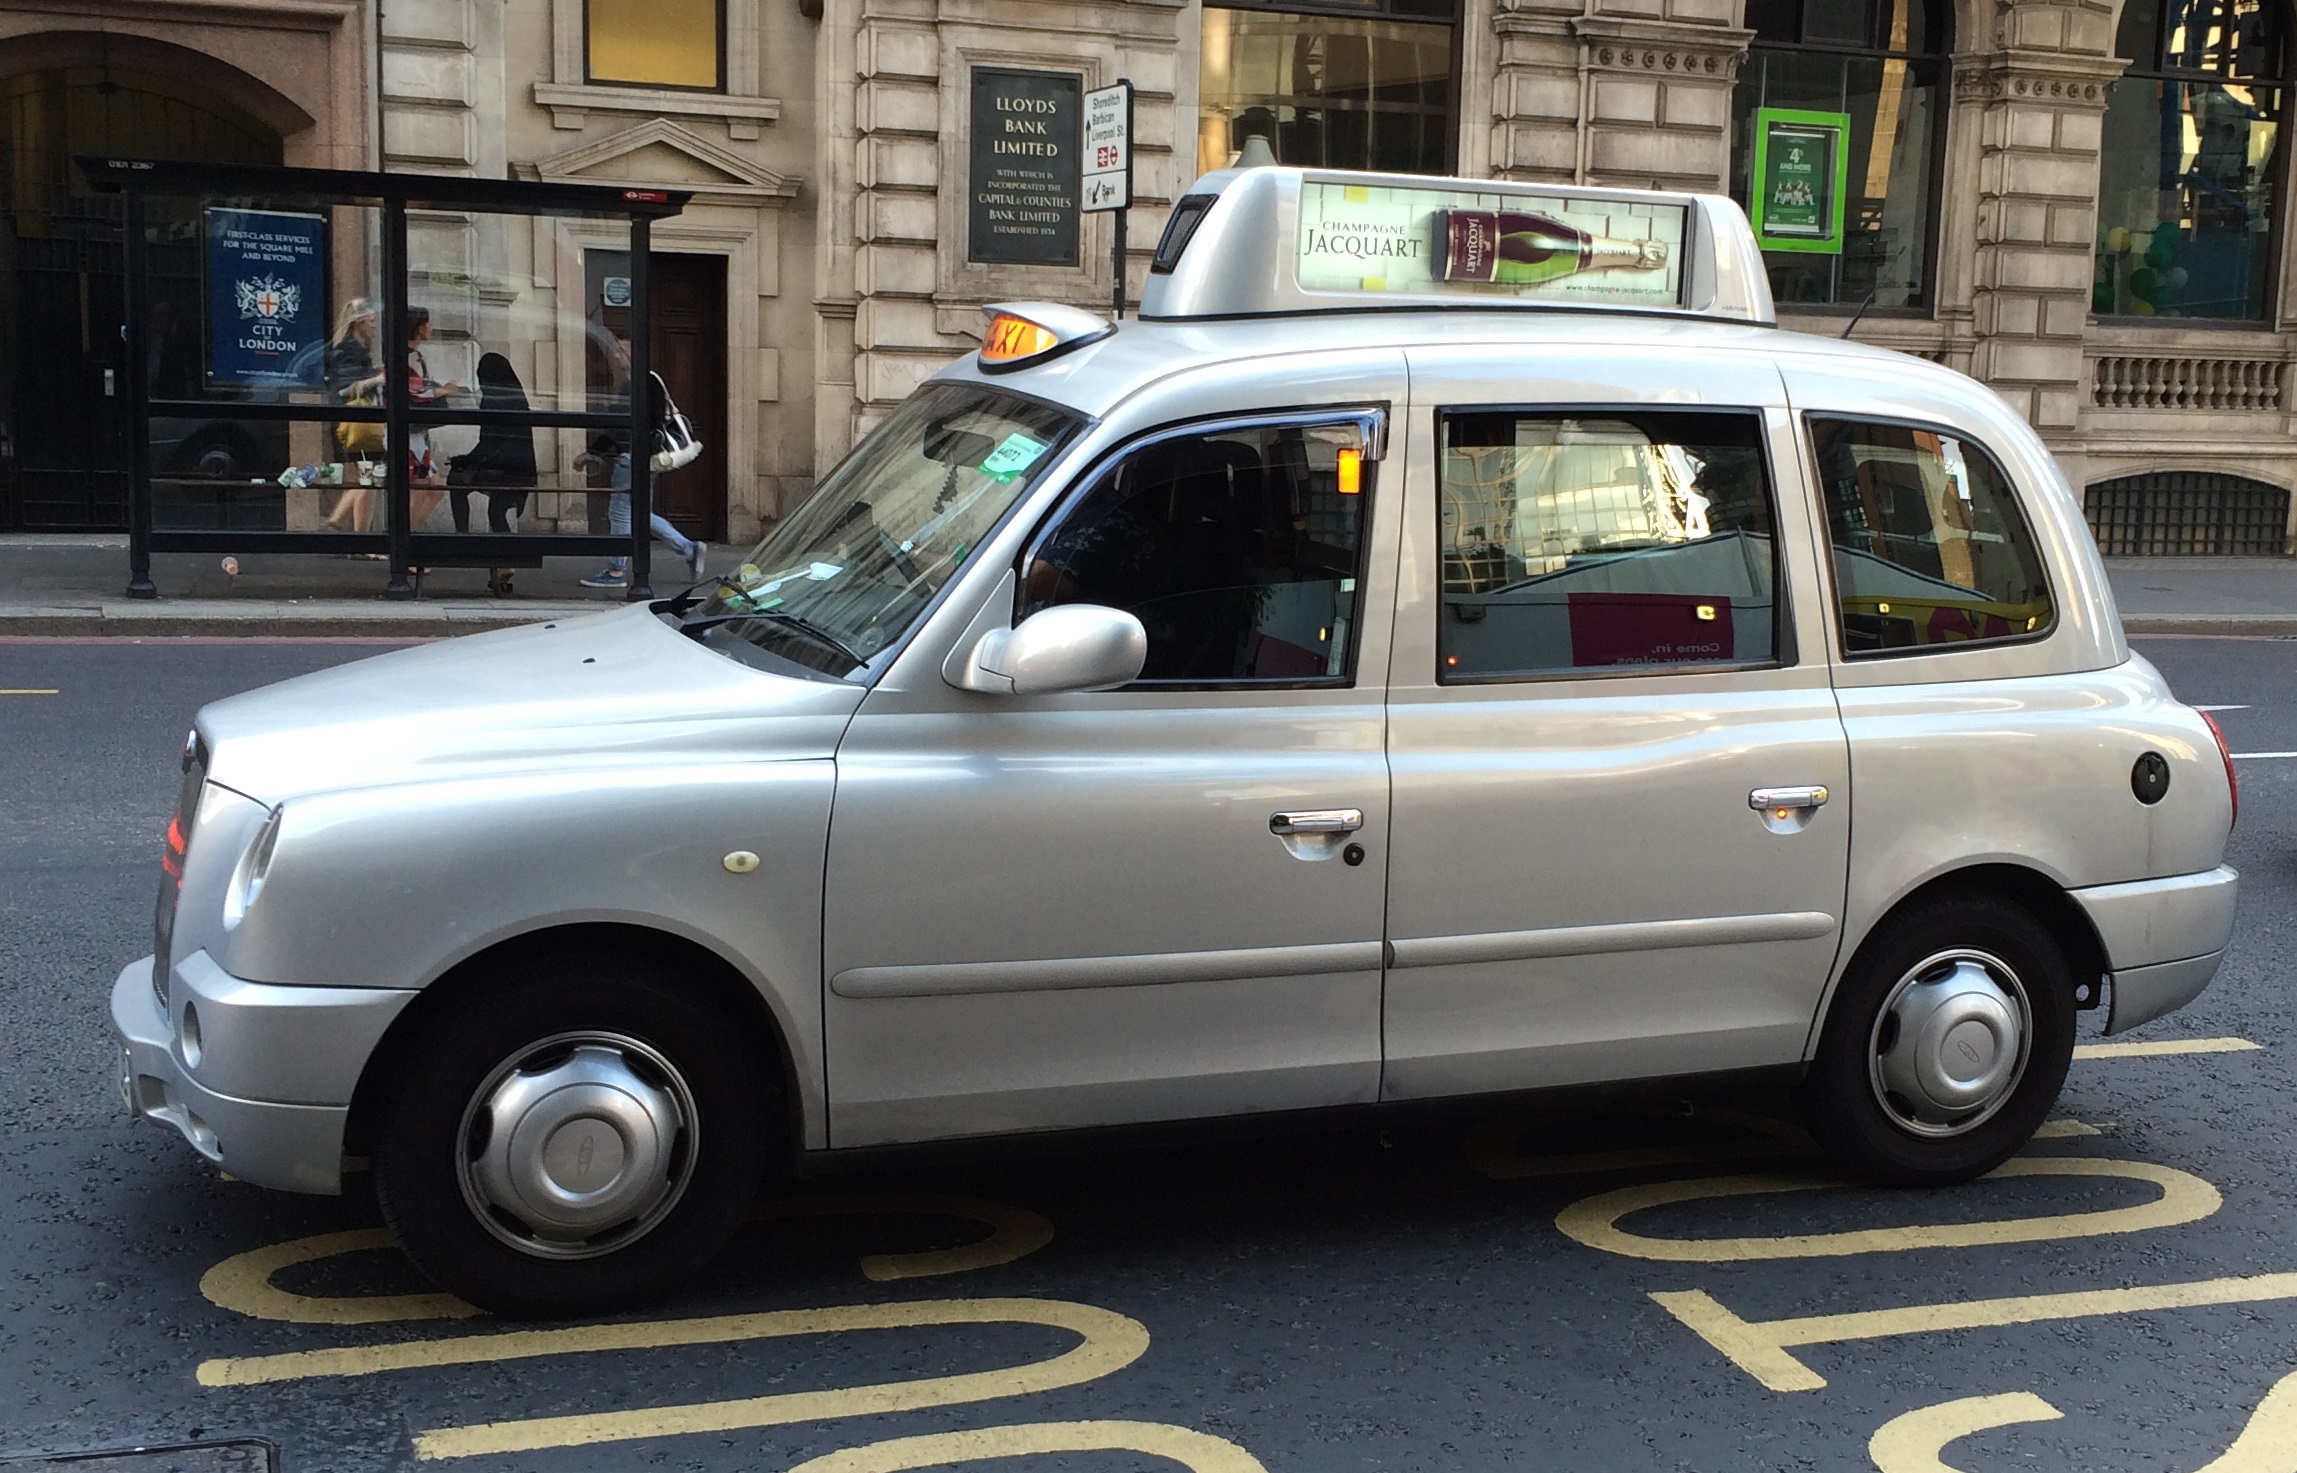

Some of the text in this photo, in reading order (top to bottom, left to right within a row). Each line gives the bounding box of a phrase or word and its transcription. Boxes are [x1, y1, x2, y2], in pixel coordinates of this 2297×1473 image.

[996, 97, 1056, 114] LLOYDS
[1093, 94, 1120, 110] Shoreditch
[1092, 112, 1114, 126] Barbican
[1005, 119, 1047, 135] BANK
[1092, 126, 1115, 141] Liverpool
[994, 140, 1058, 157] LIMITED
[996, 169, 1016, 178] WITH
[1019, 170, 1045, 179] WHICH
[1779, 162, 1812, 172] AND MORE
[987, 181, 1061, 192] INCORPORATED THE
[1102, 183, 1115, 198] Bank
[978, 193, 1015, 205] CAPITAL
[1022, 195, 1071, 208] COUNTIES
[989, 209, 1061, 223] BANK LIMITED
[993, 226, 1039, 235] ESTABLISHED
[1322, 221, 1406, 235] CHAMPAGNE
[227, 230, 310, 244] FIRST-CLASS SERVICES
[223, 240, 314, 255] FOR THE SQUARE MILE
[1303, 229, 1422, 260] JACQUART
[1465, 217, 1480, 273] JACQUART
[242, 252, 295, 263] AND BEYOND
[252, 325, 283, 337] CITY
[239, 338, 296, 352] LONDON
[985, 322, 1026, 355] AXI
